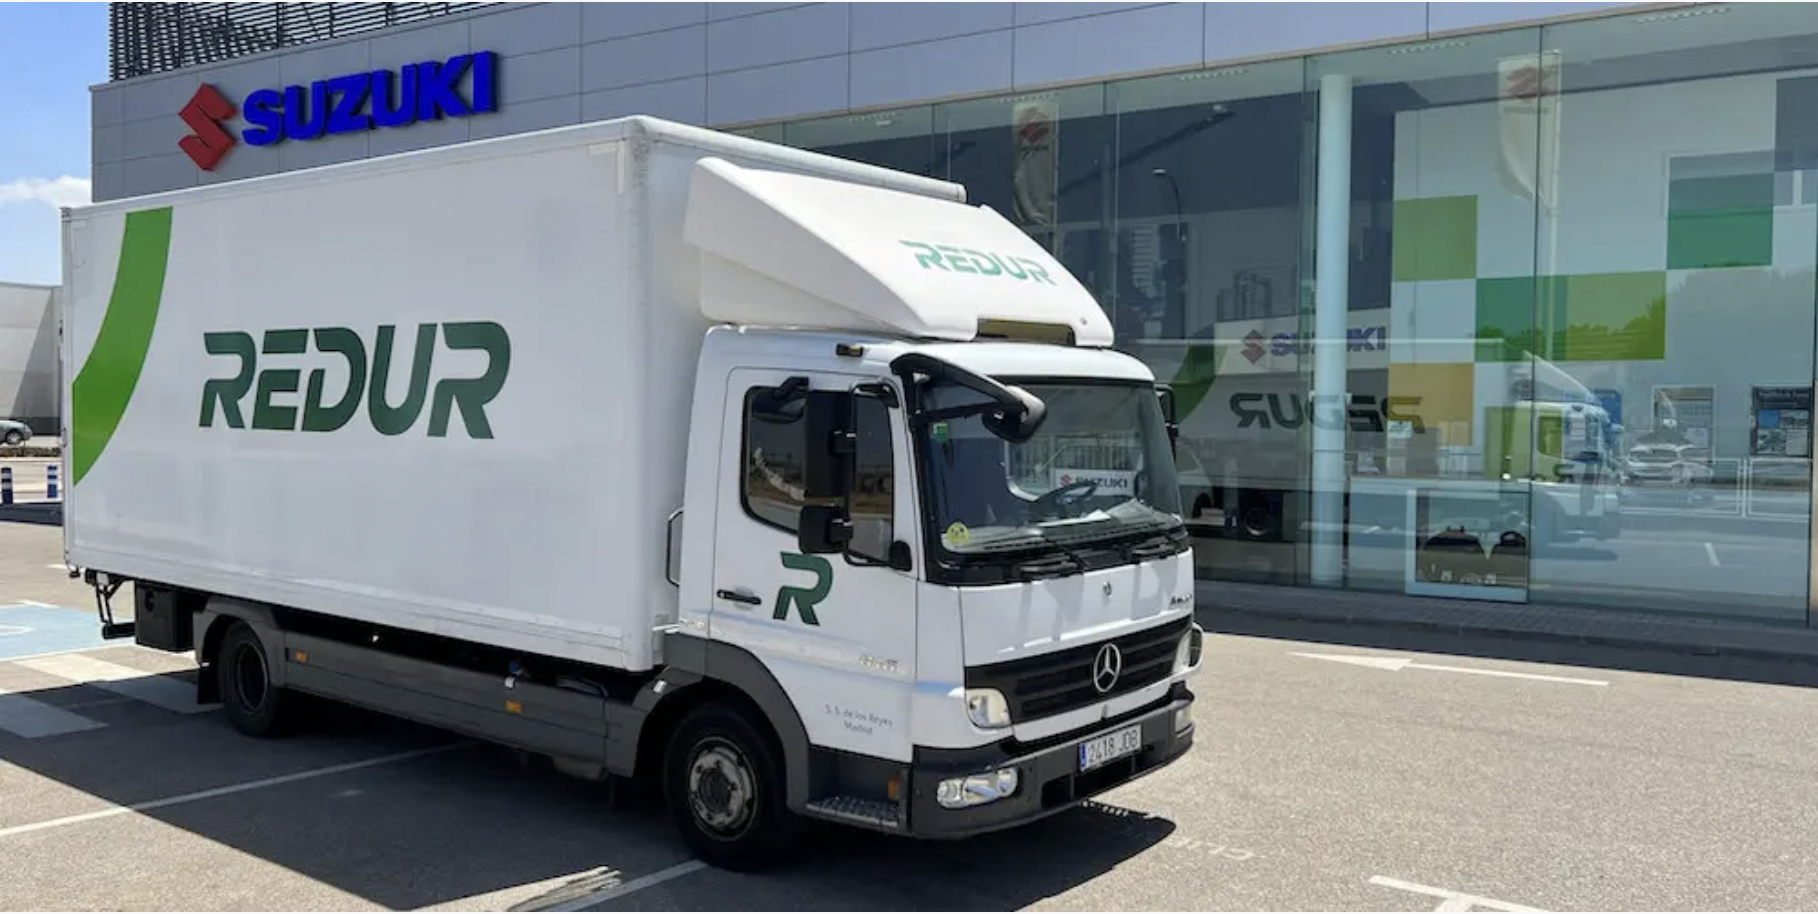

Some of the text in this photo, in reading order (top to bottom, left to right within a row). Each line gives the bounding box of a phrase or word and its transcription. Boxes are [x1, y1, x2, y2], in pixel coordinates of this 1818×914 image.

[242, 51, 498, 146] SUZUKI
[898, 239, 1058, 287] REDUR
[199, 320, 511, 440] REDUR
[773, 551, 833, 626] R
[1088, 736, 1115, 763] 2418
